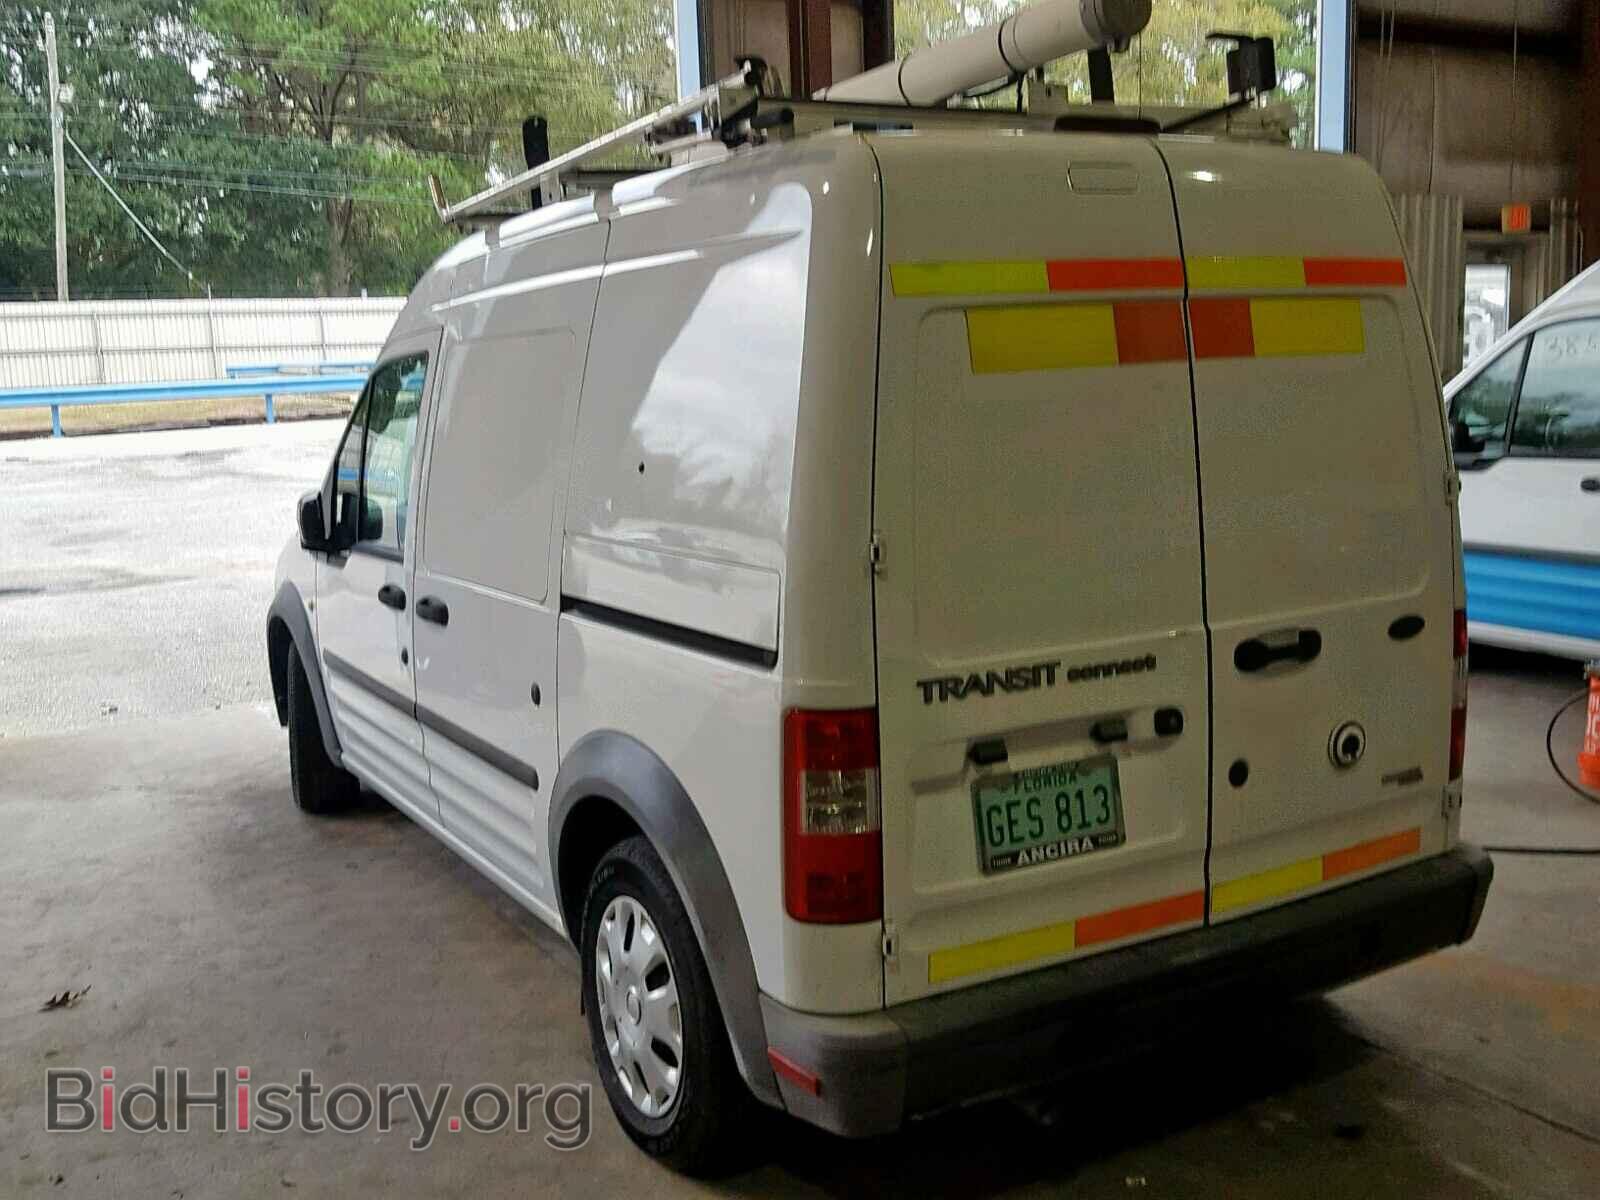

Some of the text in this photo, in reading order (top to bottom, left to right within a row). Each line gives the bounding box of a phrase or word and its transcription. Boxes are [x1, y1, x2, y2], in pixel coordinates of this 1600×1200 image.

[916, 654, 1156, 704] TRANSIT connect
[985, 784, 1110, 848] GES 813
